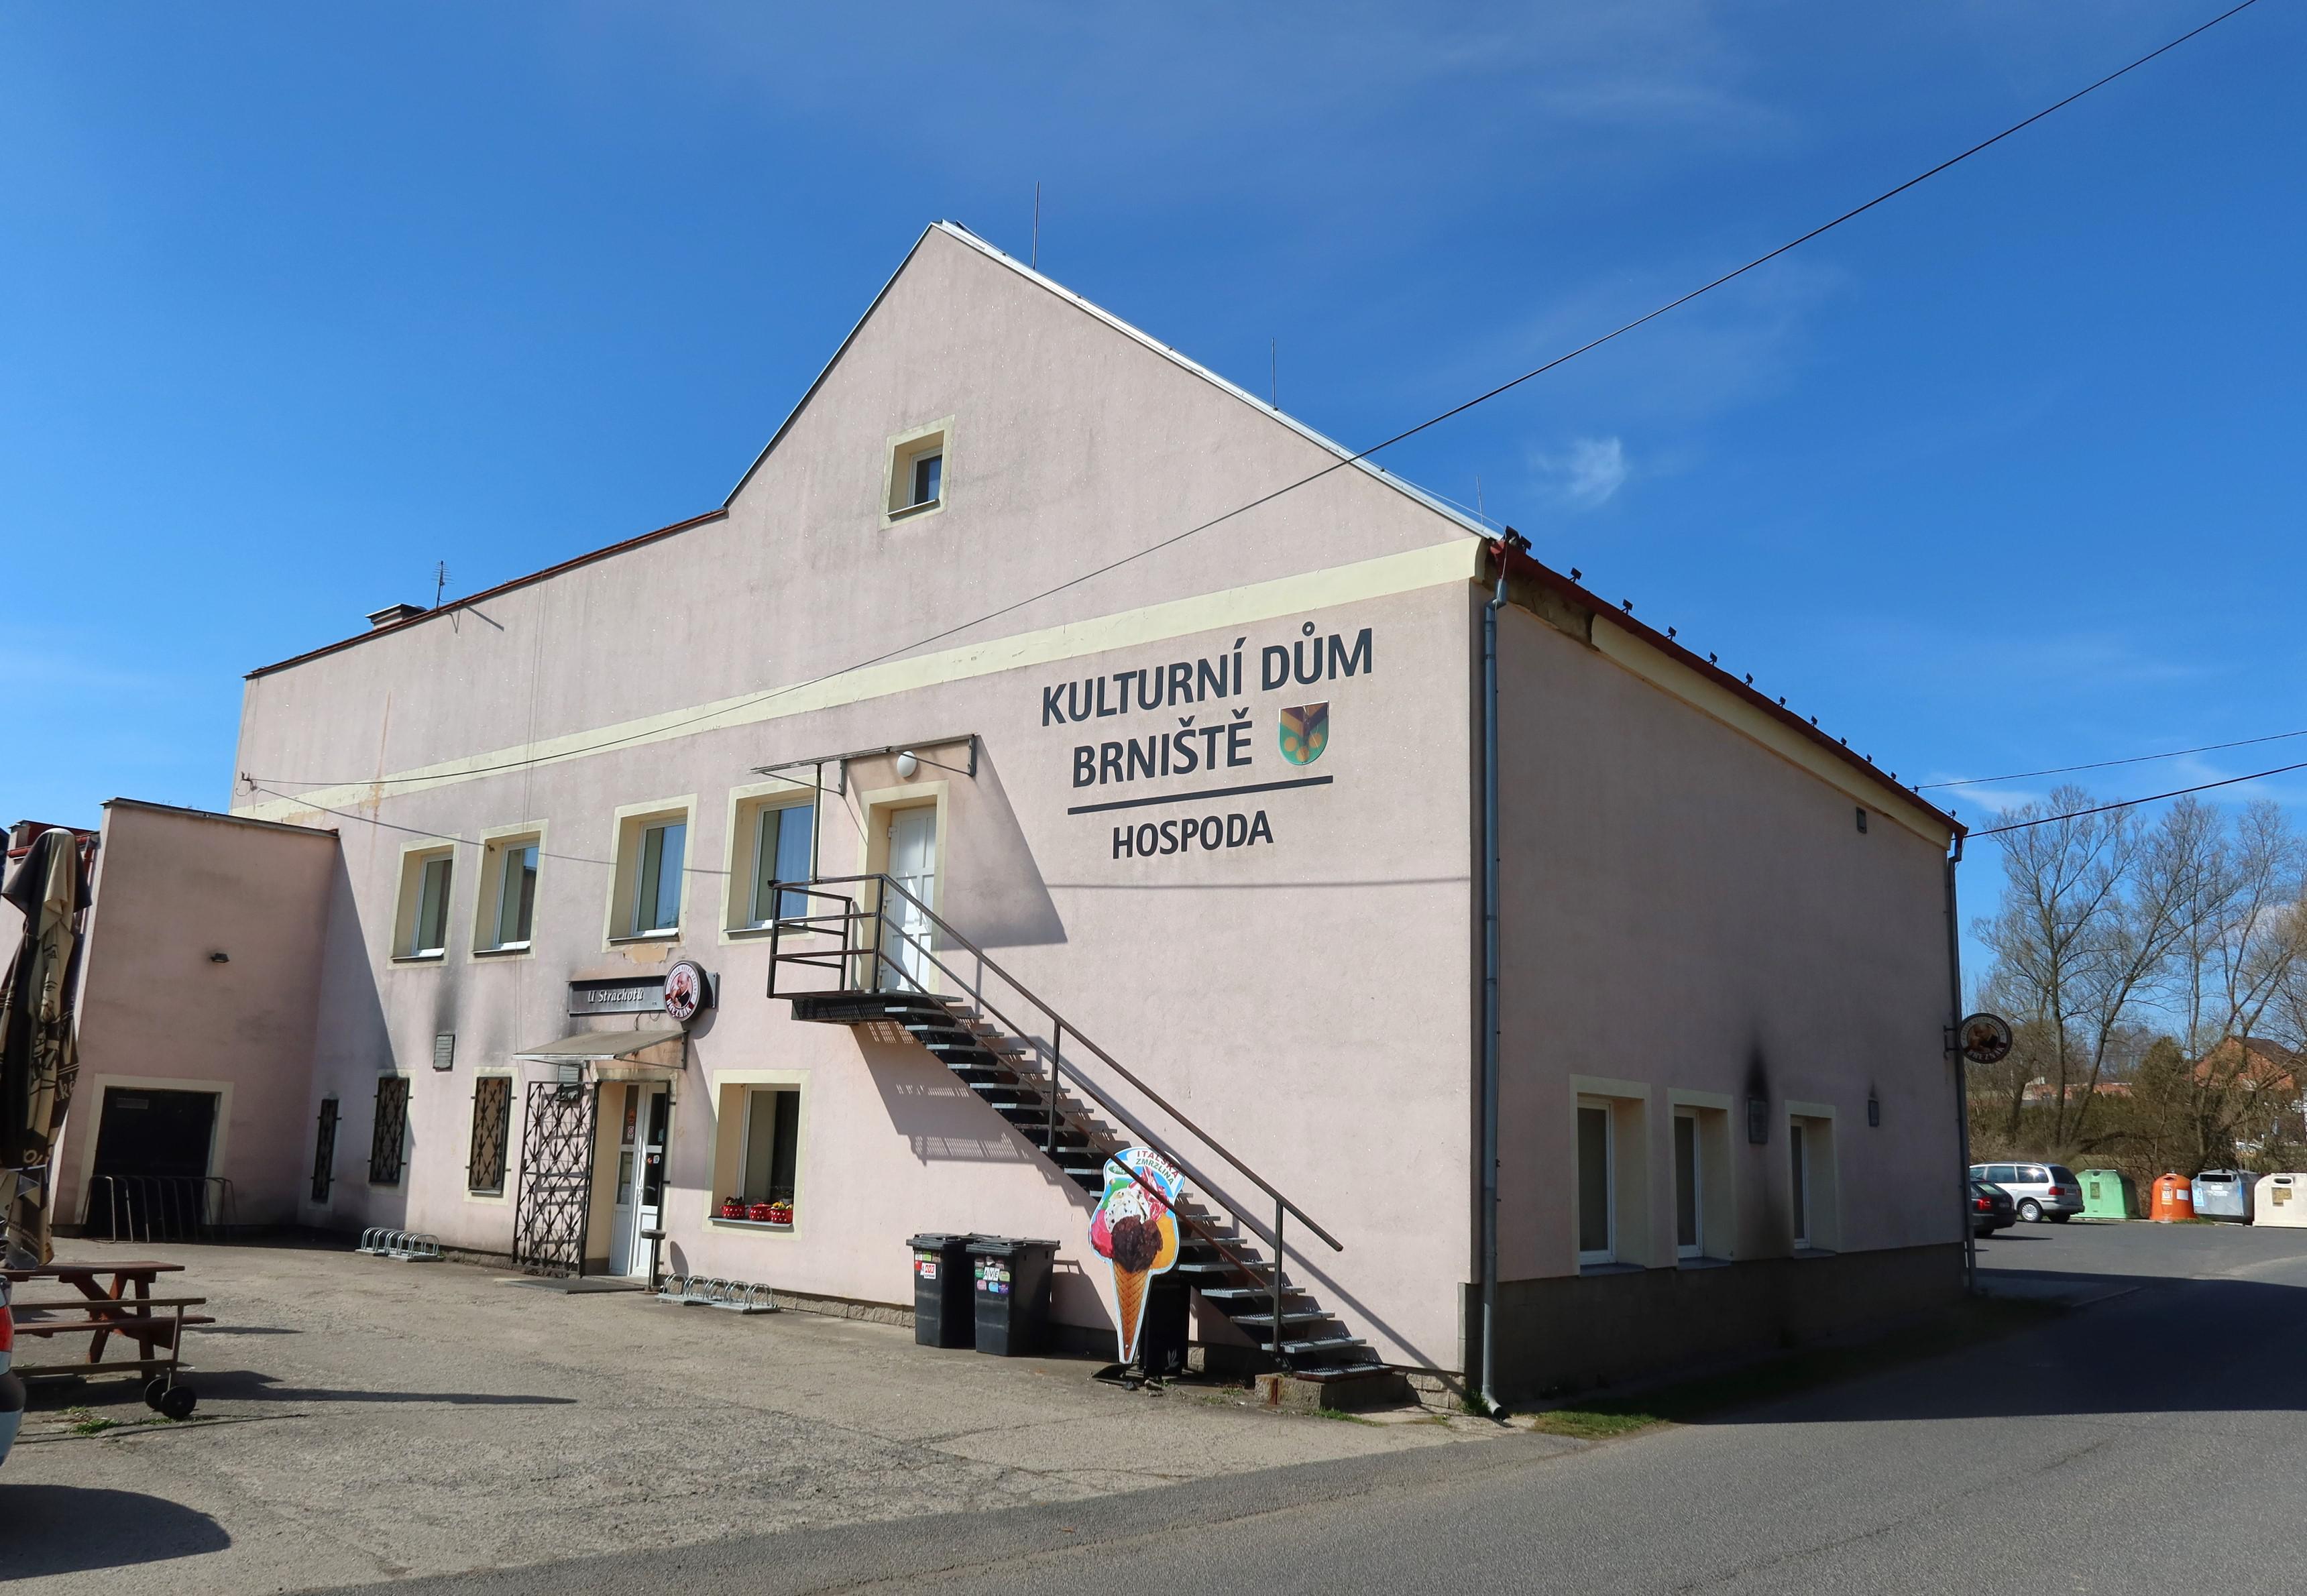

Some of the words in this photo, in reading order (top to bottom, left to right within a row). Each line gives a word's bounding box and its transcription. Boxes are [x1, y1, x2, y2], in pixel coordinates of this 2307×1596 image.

[1042, 636, 1247, 727] KULTURNÍ
[1261, 621, 1372, 691] DŮM
[1073, 707, 1253, 788] BRNIŠTĚ
[1113, 810, 1274, 860] HOSPODA
[588, 990, 596, 1003] U
[1135, 1158, 1174, 1185] ZMRZLINA
[984, 1269, 999, 1278] AVE
